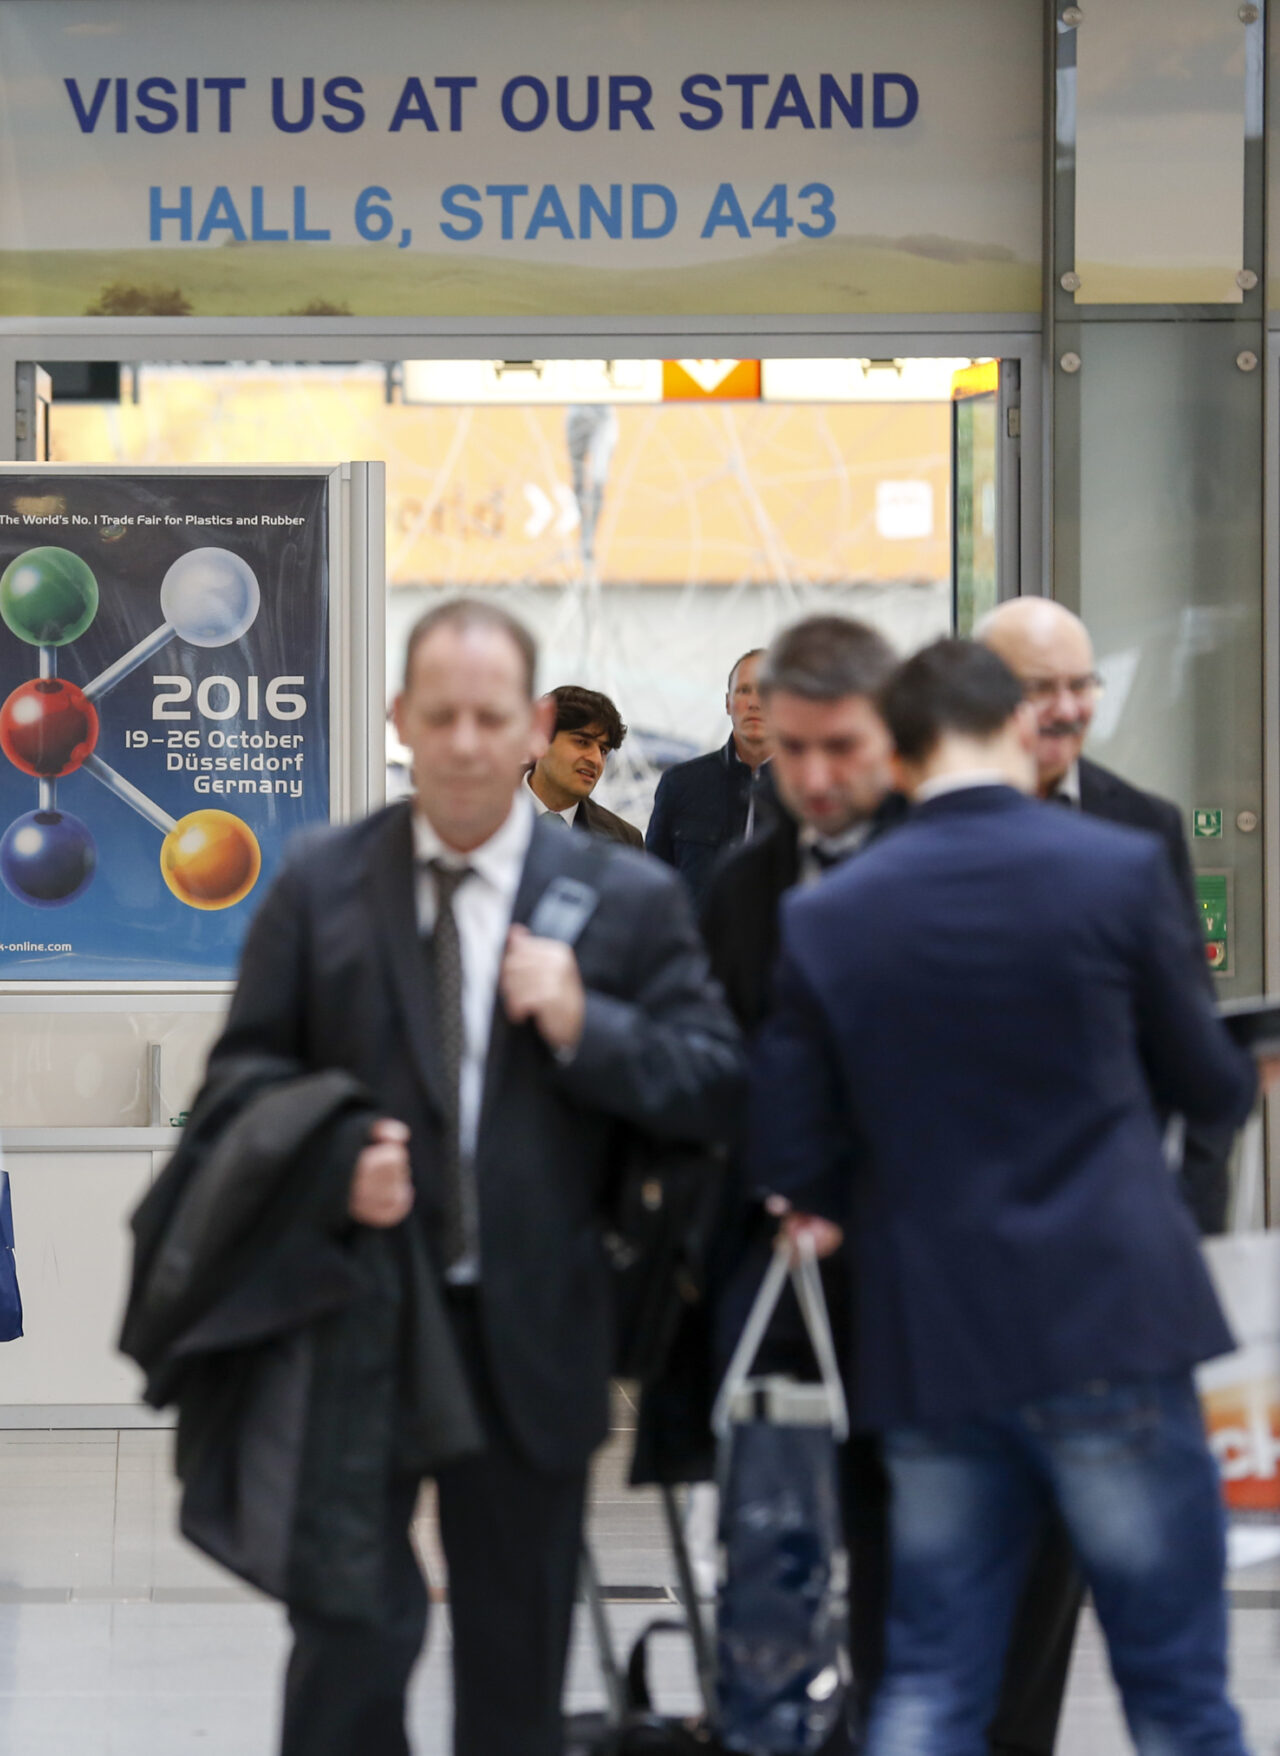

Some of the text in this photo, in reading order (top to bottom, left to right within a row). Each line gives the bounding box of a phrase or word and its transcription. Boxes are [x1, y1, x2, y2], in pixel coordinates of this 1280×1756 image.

[63, 73, 920, 134] VISIT US AT OUR STAND
[149, 182, 837, 249] HALL 6, STAND A43
[23, 514, 69, 525] World's
[72, 514, 92, 525] No.
[100, 514, 134, 526] Trade
[137, 514, 162, 525] Fair
[164, 514, 183, 526] for
[185, 514, 233, 526] Plastics
[236, 515, 258, 526] and
[261, 515, 305, 526] Rubber
[152, 675, 307, 721] 2016
[207, 730, 304, 749] October
[166, 752, 304, 771] Düsseldorf
[193, 775, 303, 797] Germany
